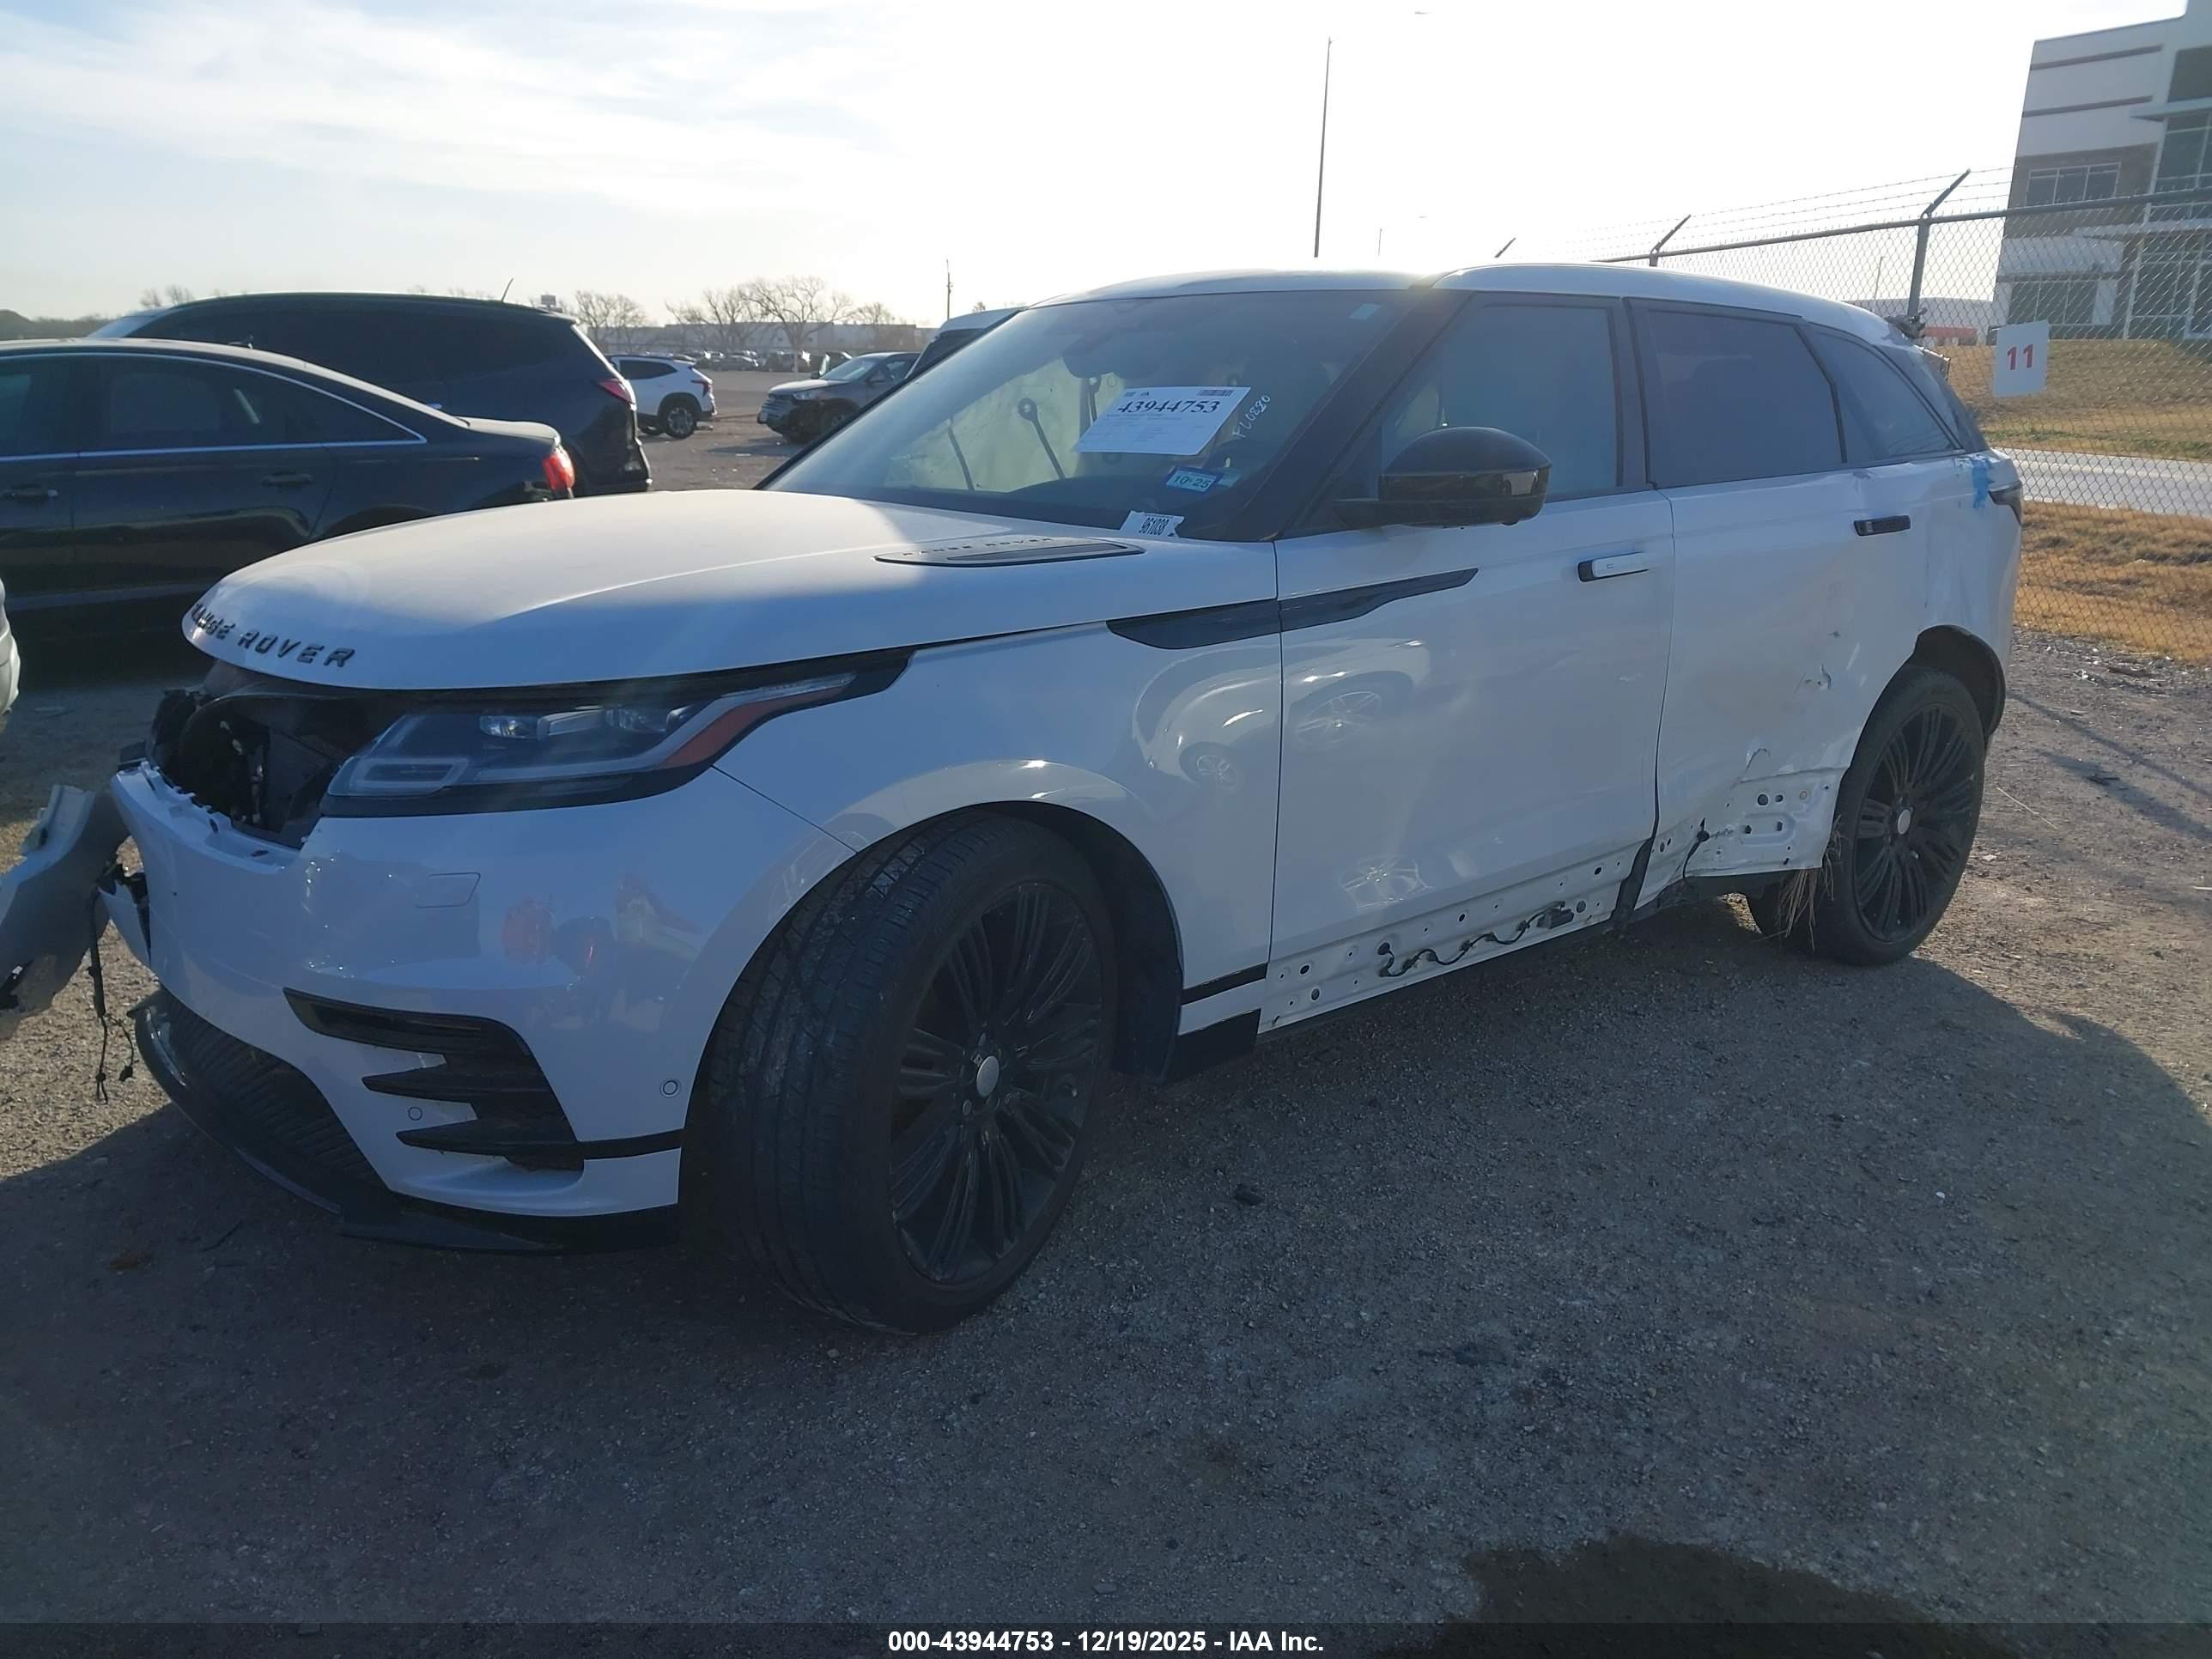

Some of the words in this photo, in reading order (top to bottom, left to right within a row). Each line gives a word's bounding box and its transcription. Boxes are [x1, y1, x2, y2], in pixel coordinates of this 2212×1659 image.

[2007, 343, 2034, 371] 11
[1117, 400, 1221, 413] 43944753
[237, 631, 356, 668] ROVER
